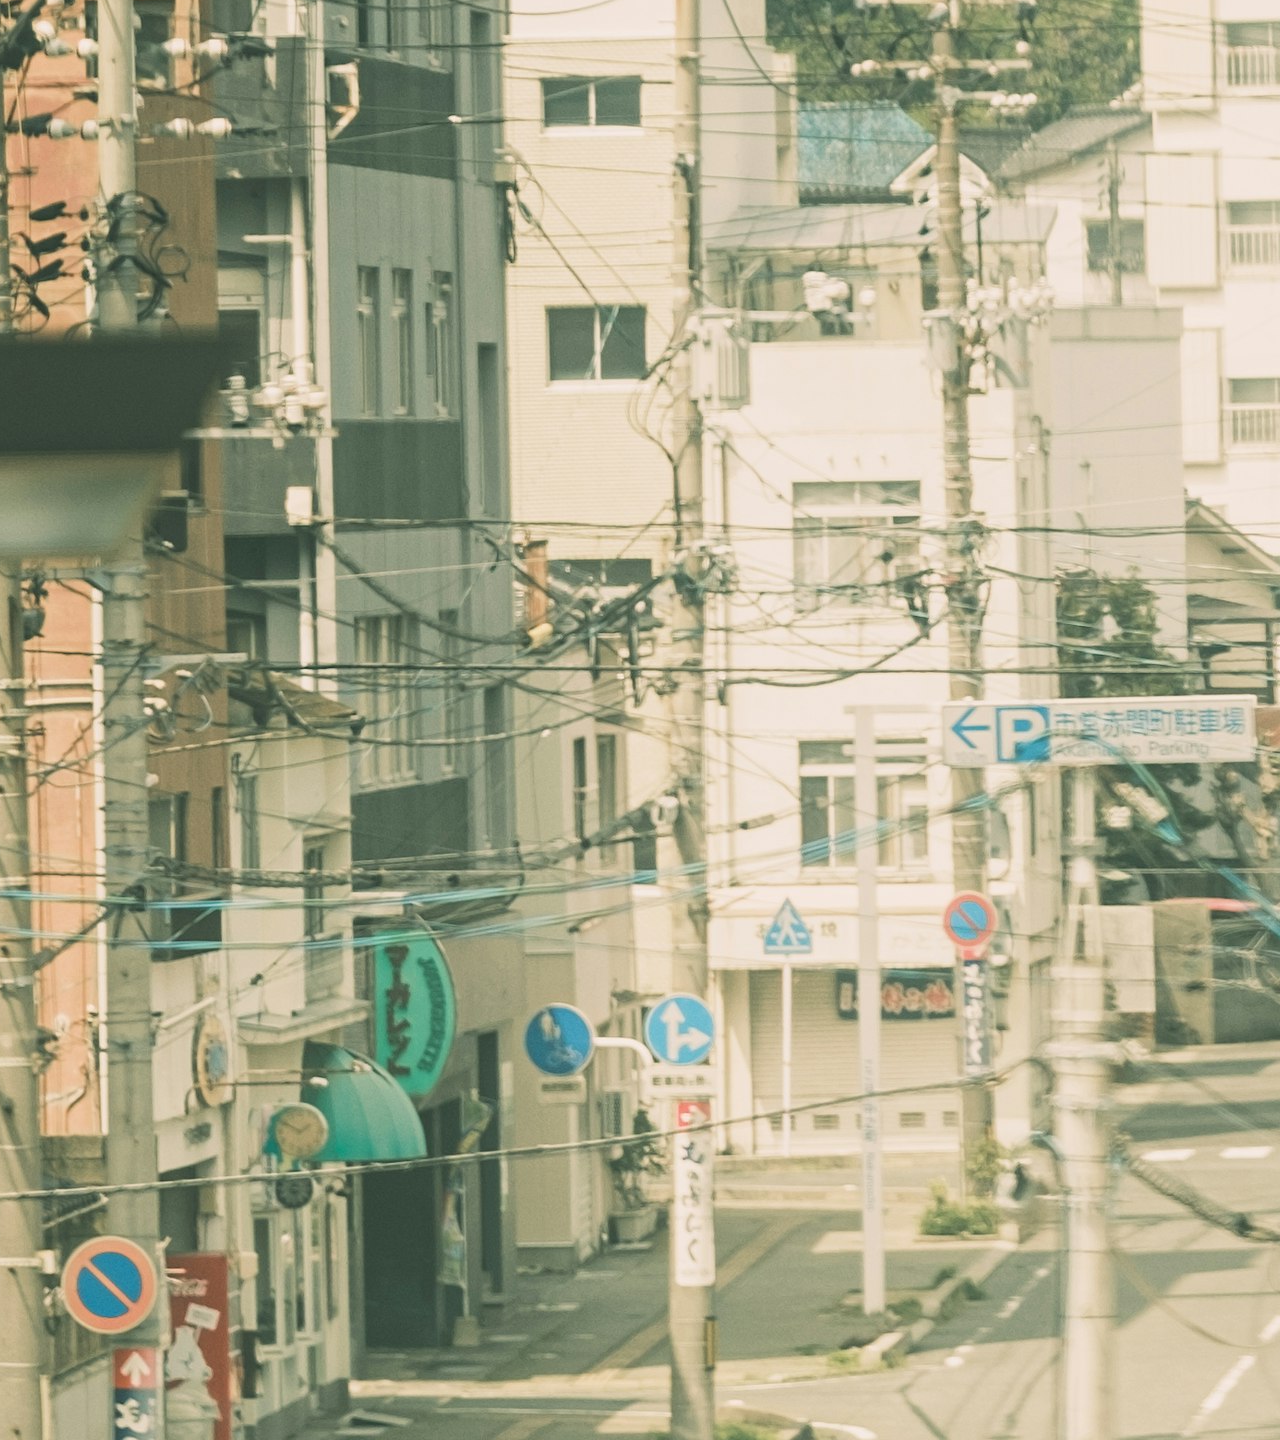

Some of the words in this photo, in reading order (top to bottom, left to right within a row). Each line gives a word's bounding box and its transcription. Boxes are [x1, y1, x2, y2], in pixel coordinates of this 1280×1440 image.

[999, 709, 1046, 760] P
[1055, 707, 1245, 738] 市営赤間町駐車場
[1149, 740, 1209, 759] Parking
